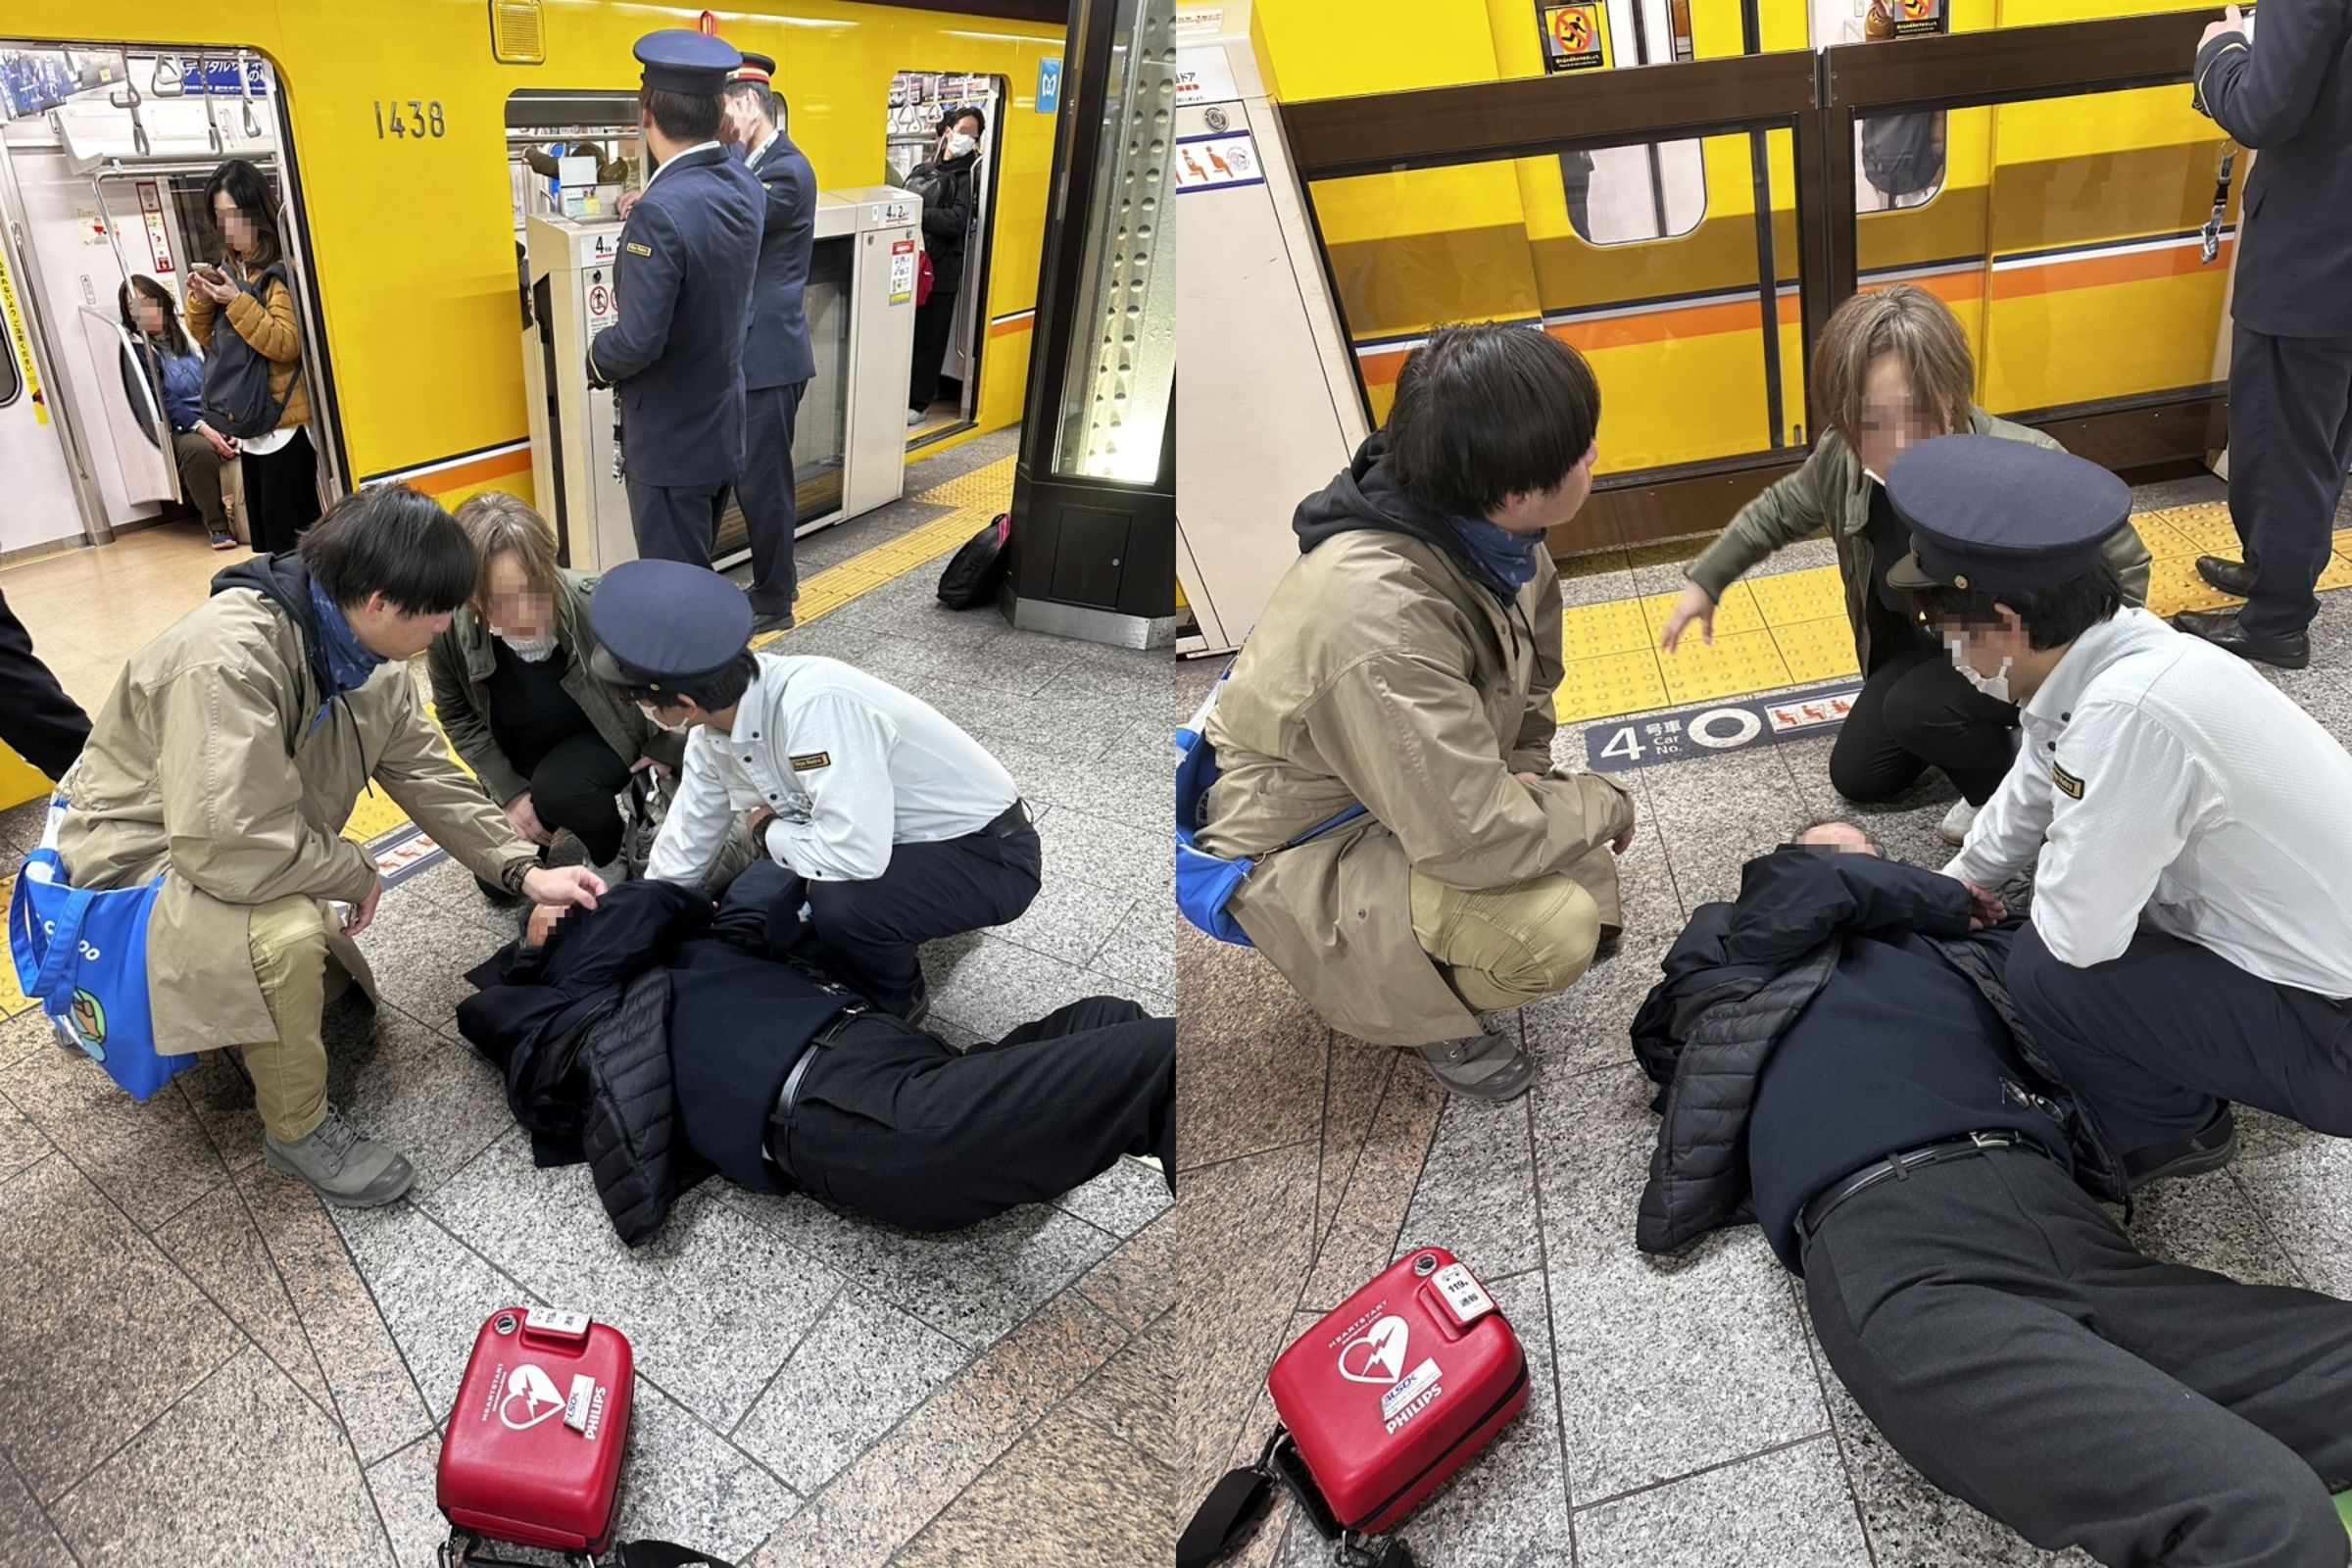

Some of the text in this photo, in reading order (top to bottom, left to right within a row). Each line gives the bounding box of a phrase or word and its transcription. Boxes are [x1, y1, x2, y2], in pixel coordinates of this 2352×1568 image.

[374, 101, 445, 139] 1438
[1600, 719, 1683, 760] 4 号車
[1653, 735, 1680, 746] Car
[1656, 745, 1683, 755] No.
[1328, 1299, 1388, 1349] HEARTSTART
[481, 1363, 505, 1422] HEARTSTART
[584, 1386, 607, 1441] PHILIPS
[1385, 1383, 1444, 1436] PHILIPS
